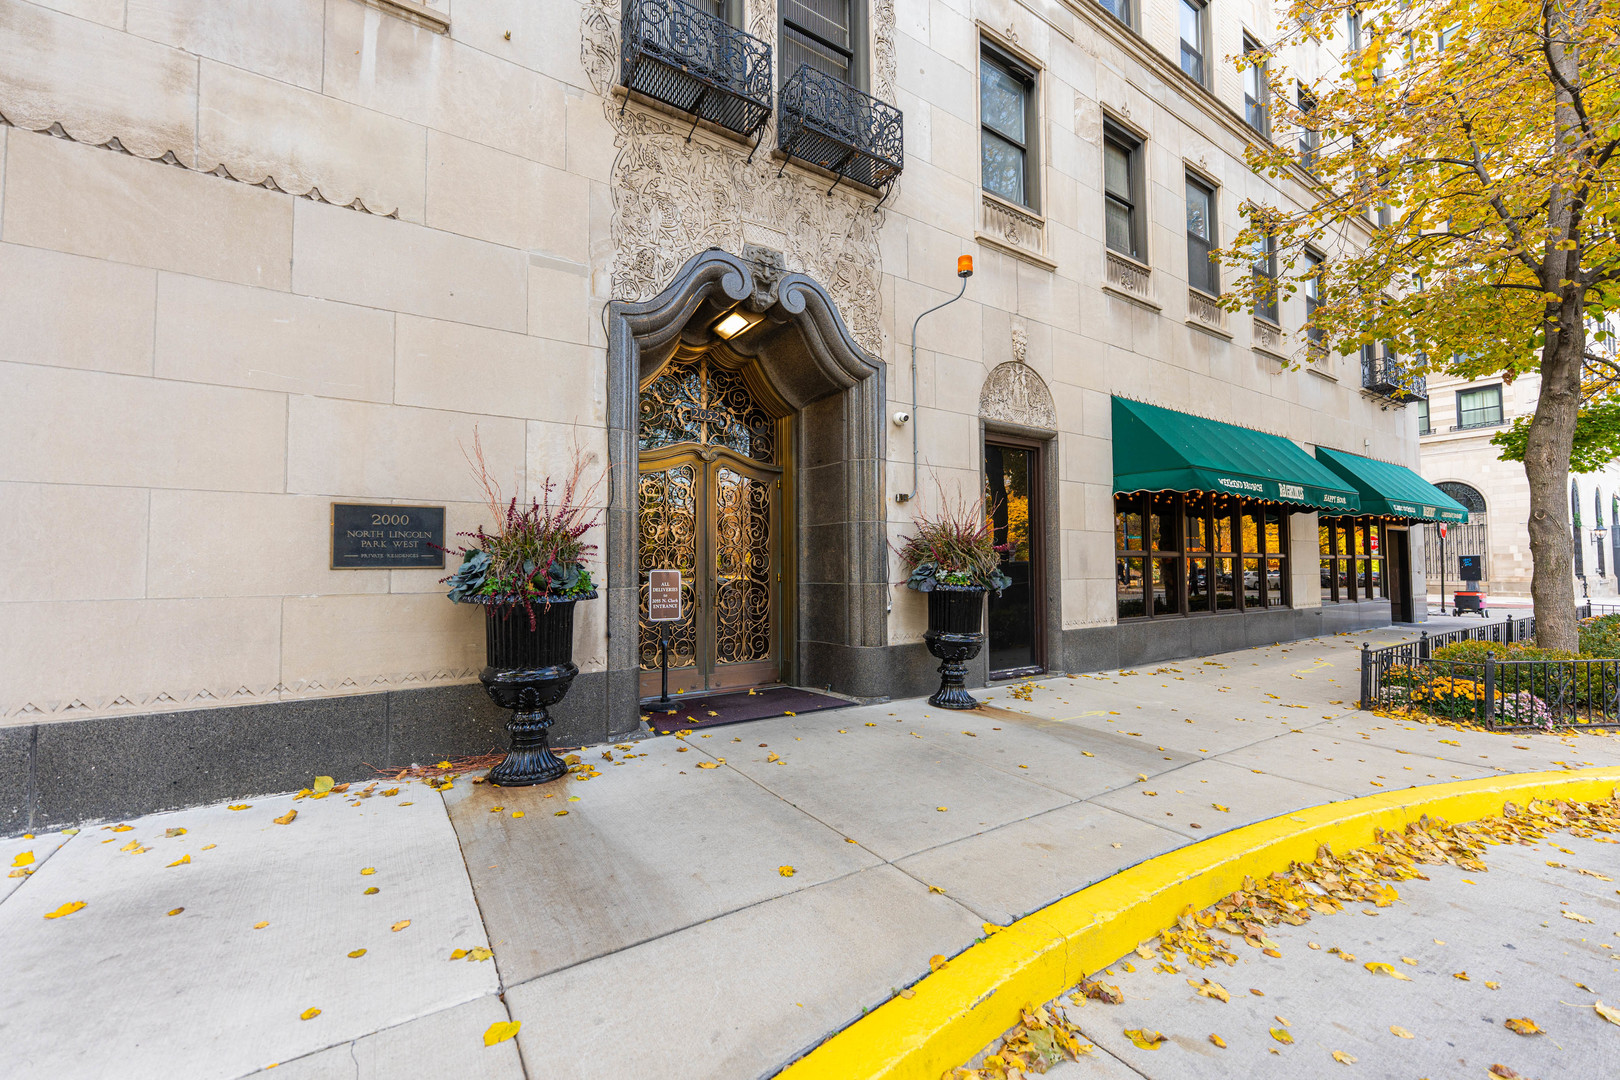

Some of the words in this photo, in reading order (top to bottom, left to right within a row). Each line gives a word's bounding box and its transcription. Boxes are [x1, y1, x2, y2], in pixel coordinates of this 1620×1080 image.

[692, 409, 719, 422] 2052
[1218, 478, 1243, 488] WEEKEND
[1324, 494, 1336, 503] HAPPY
[371, 514, 409, 525] 2000
